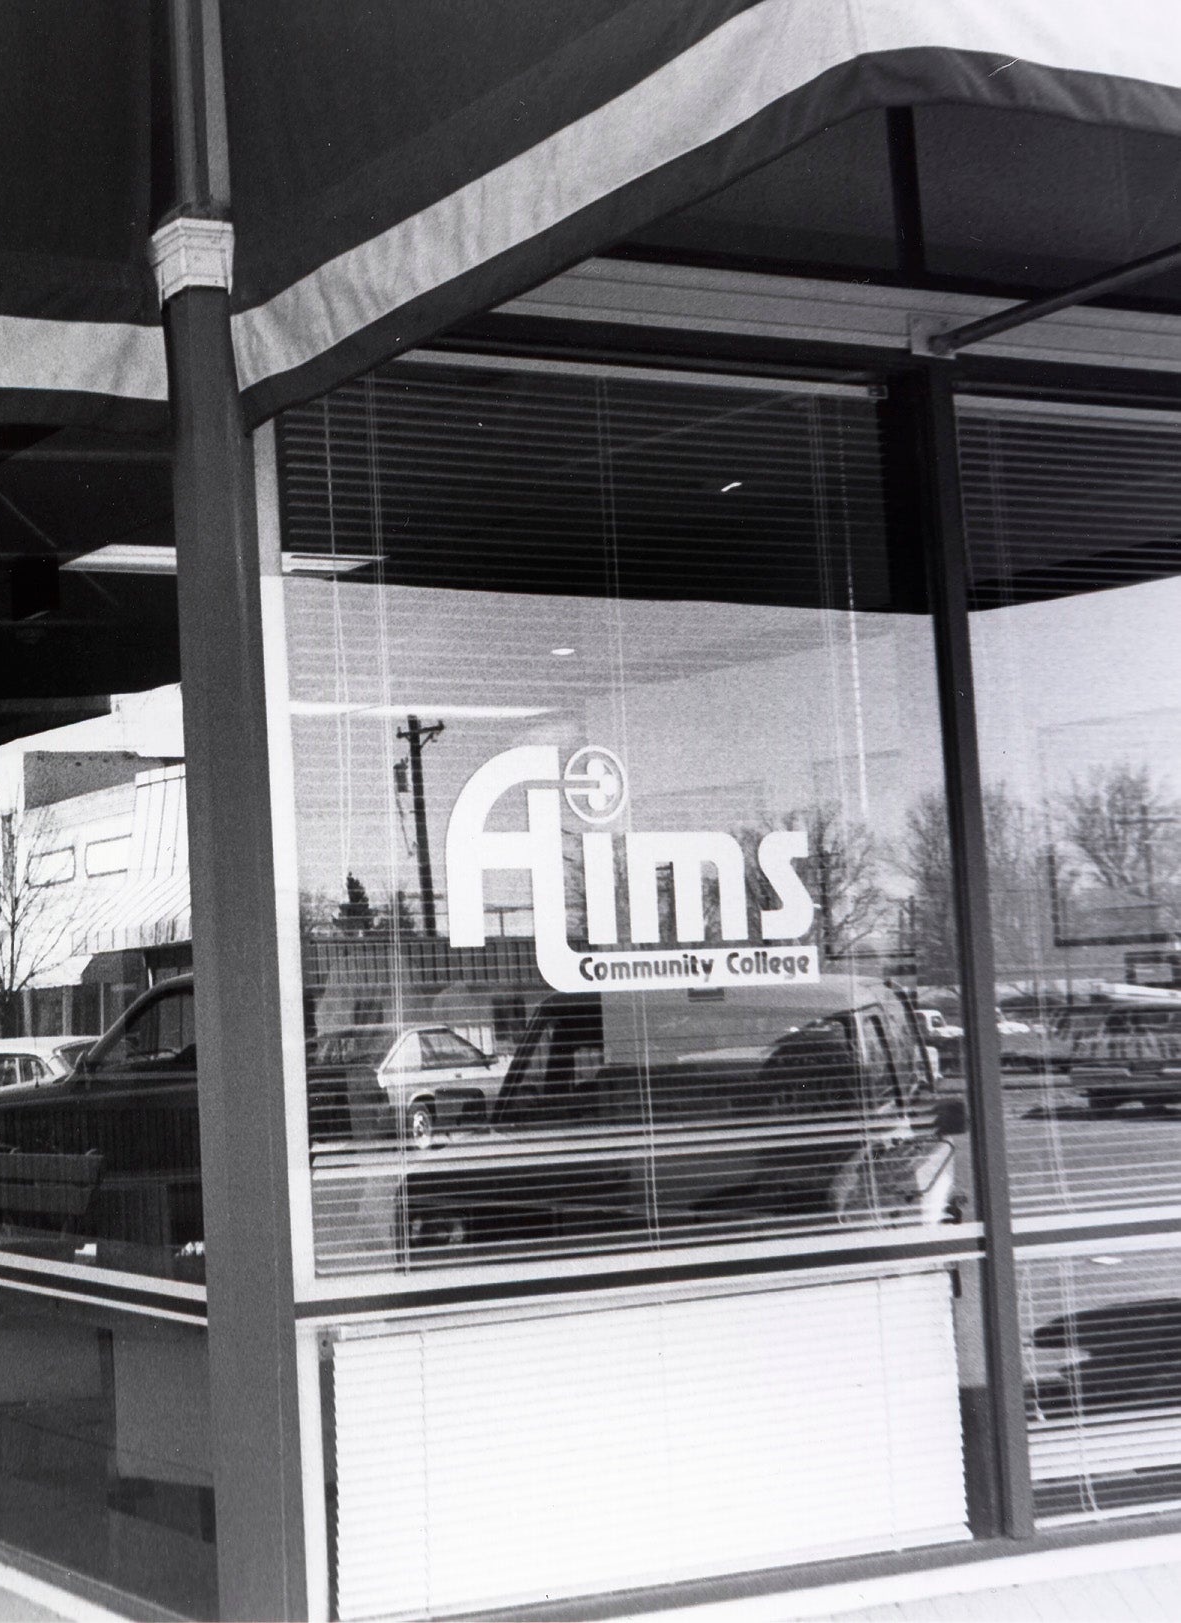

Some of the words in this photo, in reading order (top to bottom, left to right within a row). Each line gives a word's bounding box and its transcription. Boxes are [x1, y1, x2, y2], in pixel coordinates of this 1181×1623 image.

[446, 745, 814, 992] Aims
[579, 954, 714, 982] Community
[726, 951, 810, 980] College
